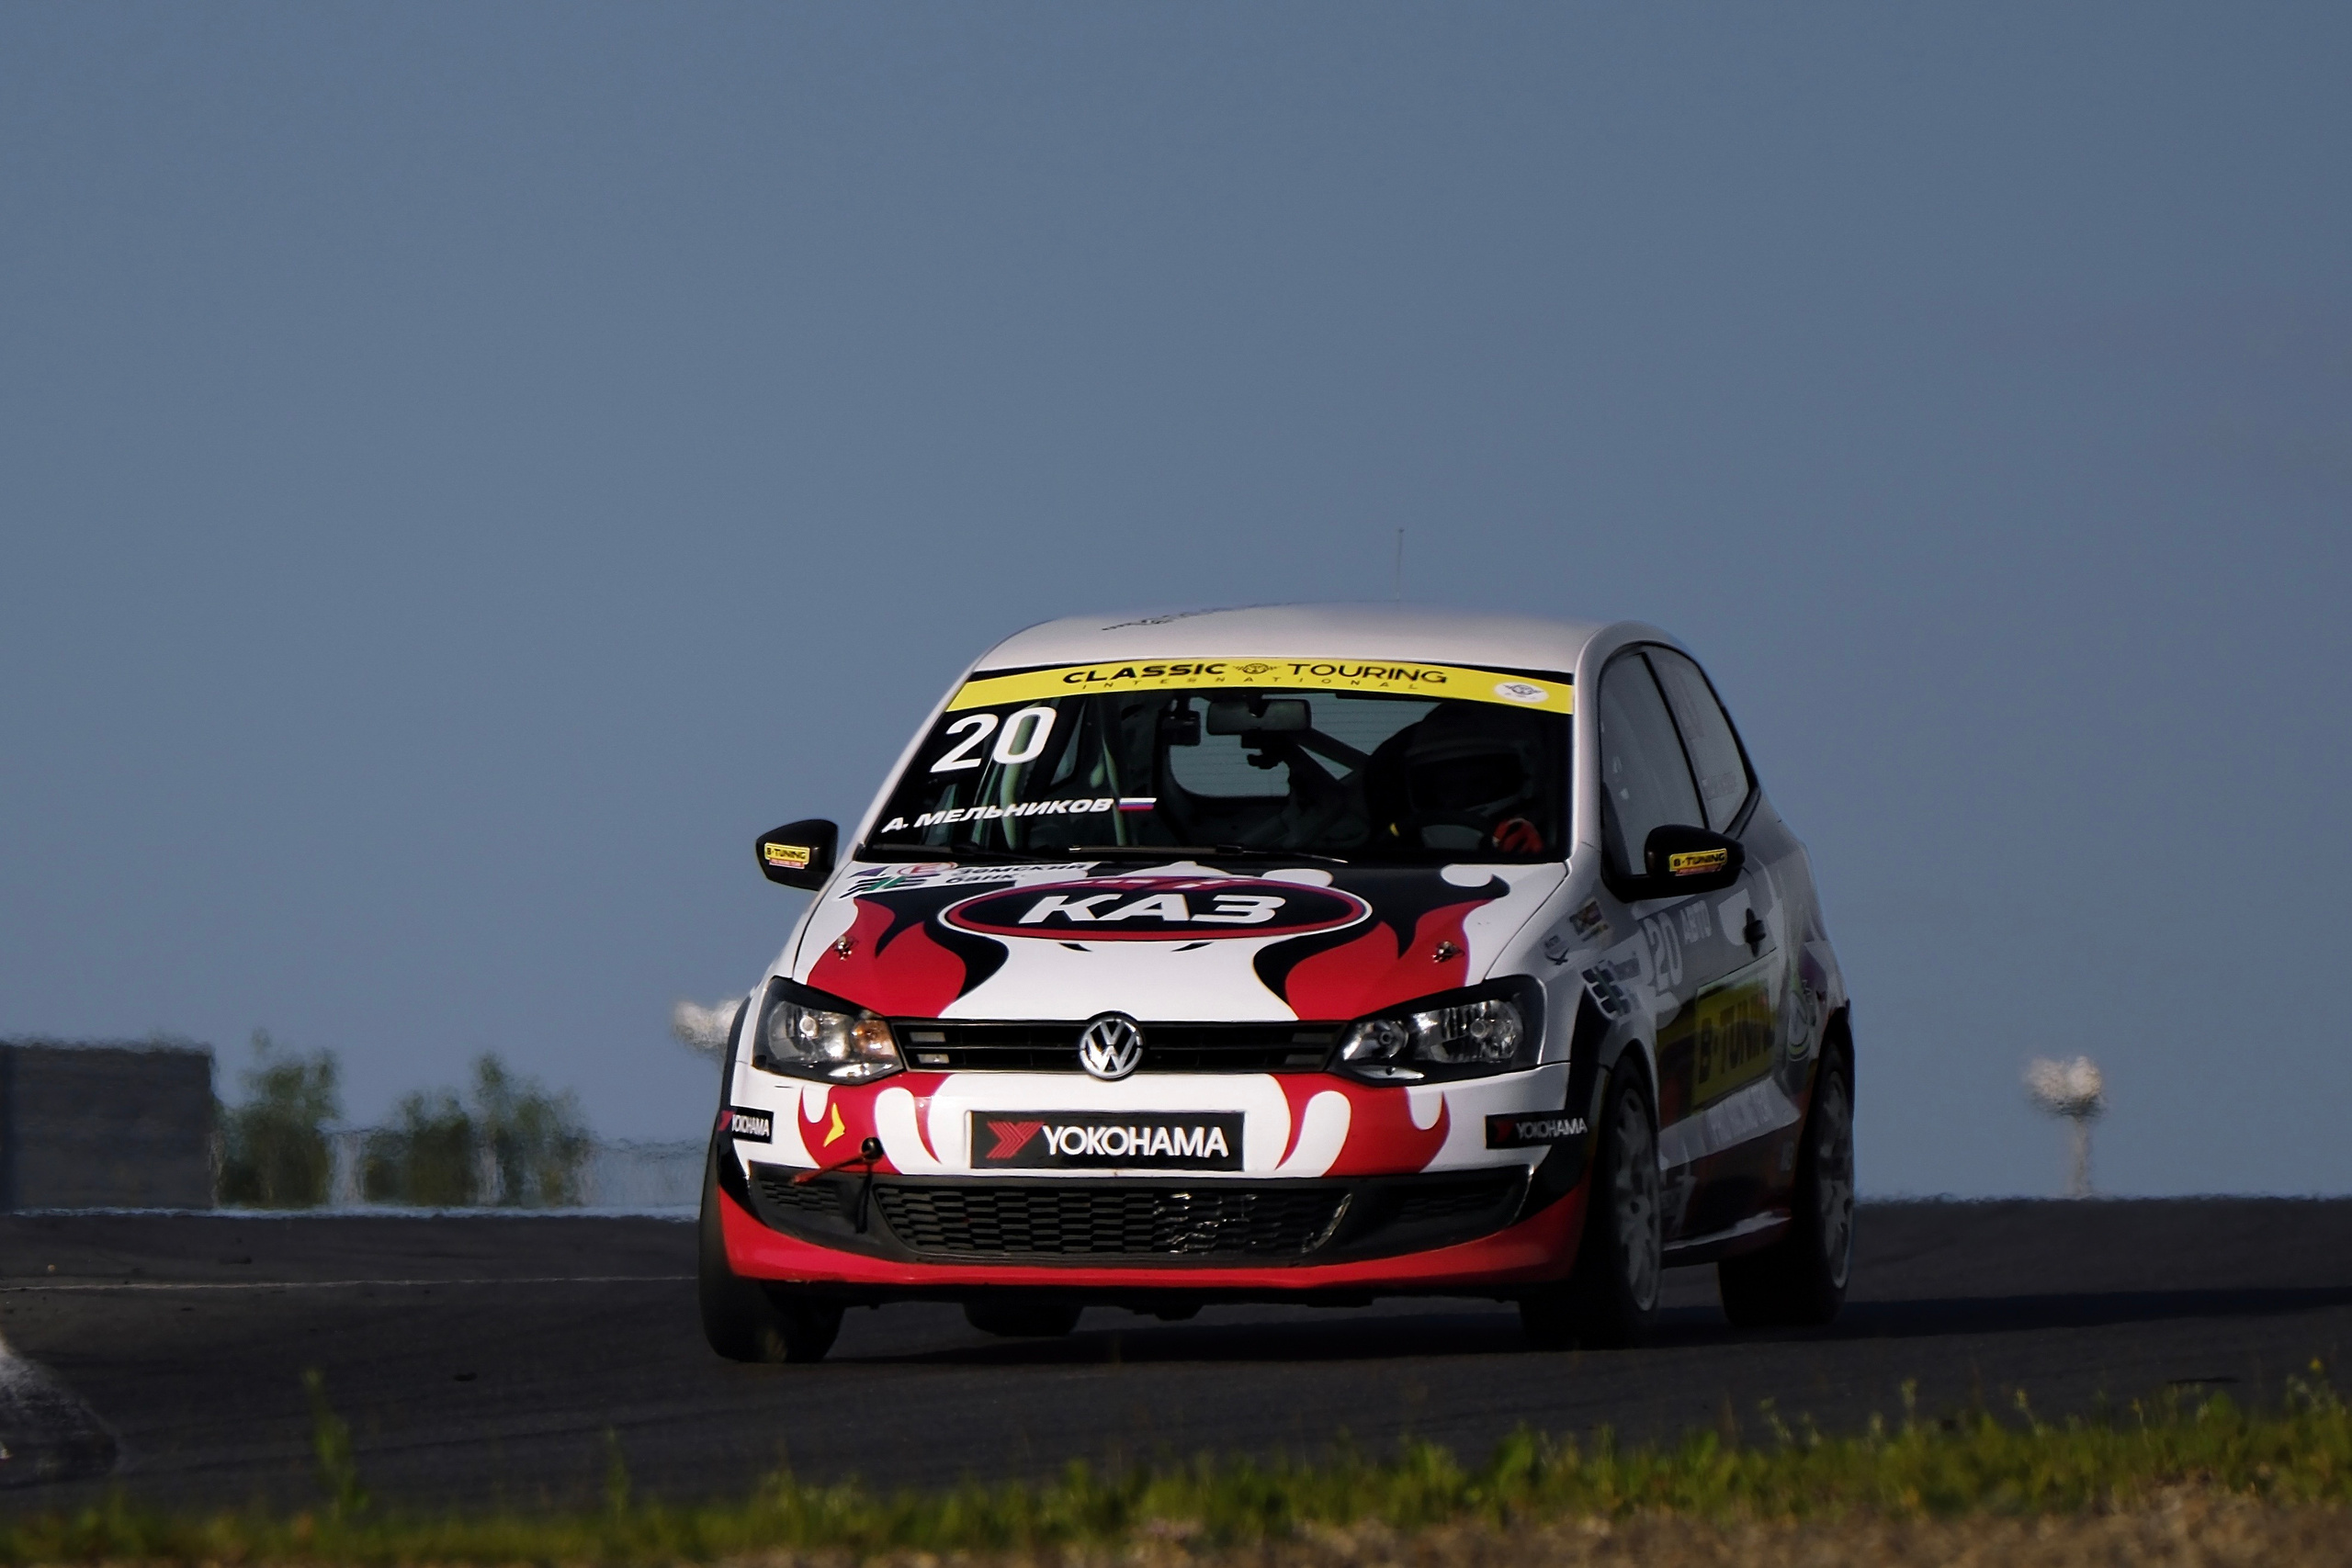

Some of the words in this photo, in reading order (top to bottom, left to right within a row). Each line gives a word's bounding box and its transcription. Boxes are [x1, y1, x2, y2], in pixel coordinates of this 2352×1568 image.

[1063, 663, 1227, 684] CLASSIC
[1287, 663, 1448, 684] TOURING
[1082, 676, 1418, 690] INTERNATIONAL
[929, 706, 1057, 773] 20
[881, 817, 909, 833] А.
[913, 797, 1114, 829] МЕЛЬНИКОВ
[766, 847, 807, 860] B-TUNING
[1673, 852, 1725, 867] B-TUNING
[1643, 911, 1683, 992] 20
[1516, 1117, 1588, 1139] YOKOHAMA
[1043, 1125, 1229, 1158] YOKOHAMA
